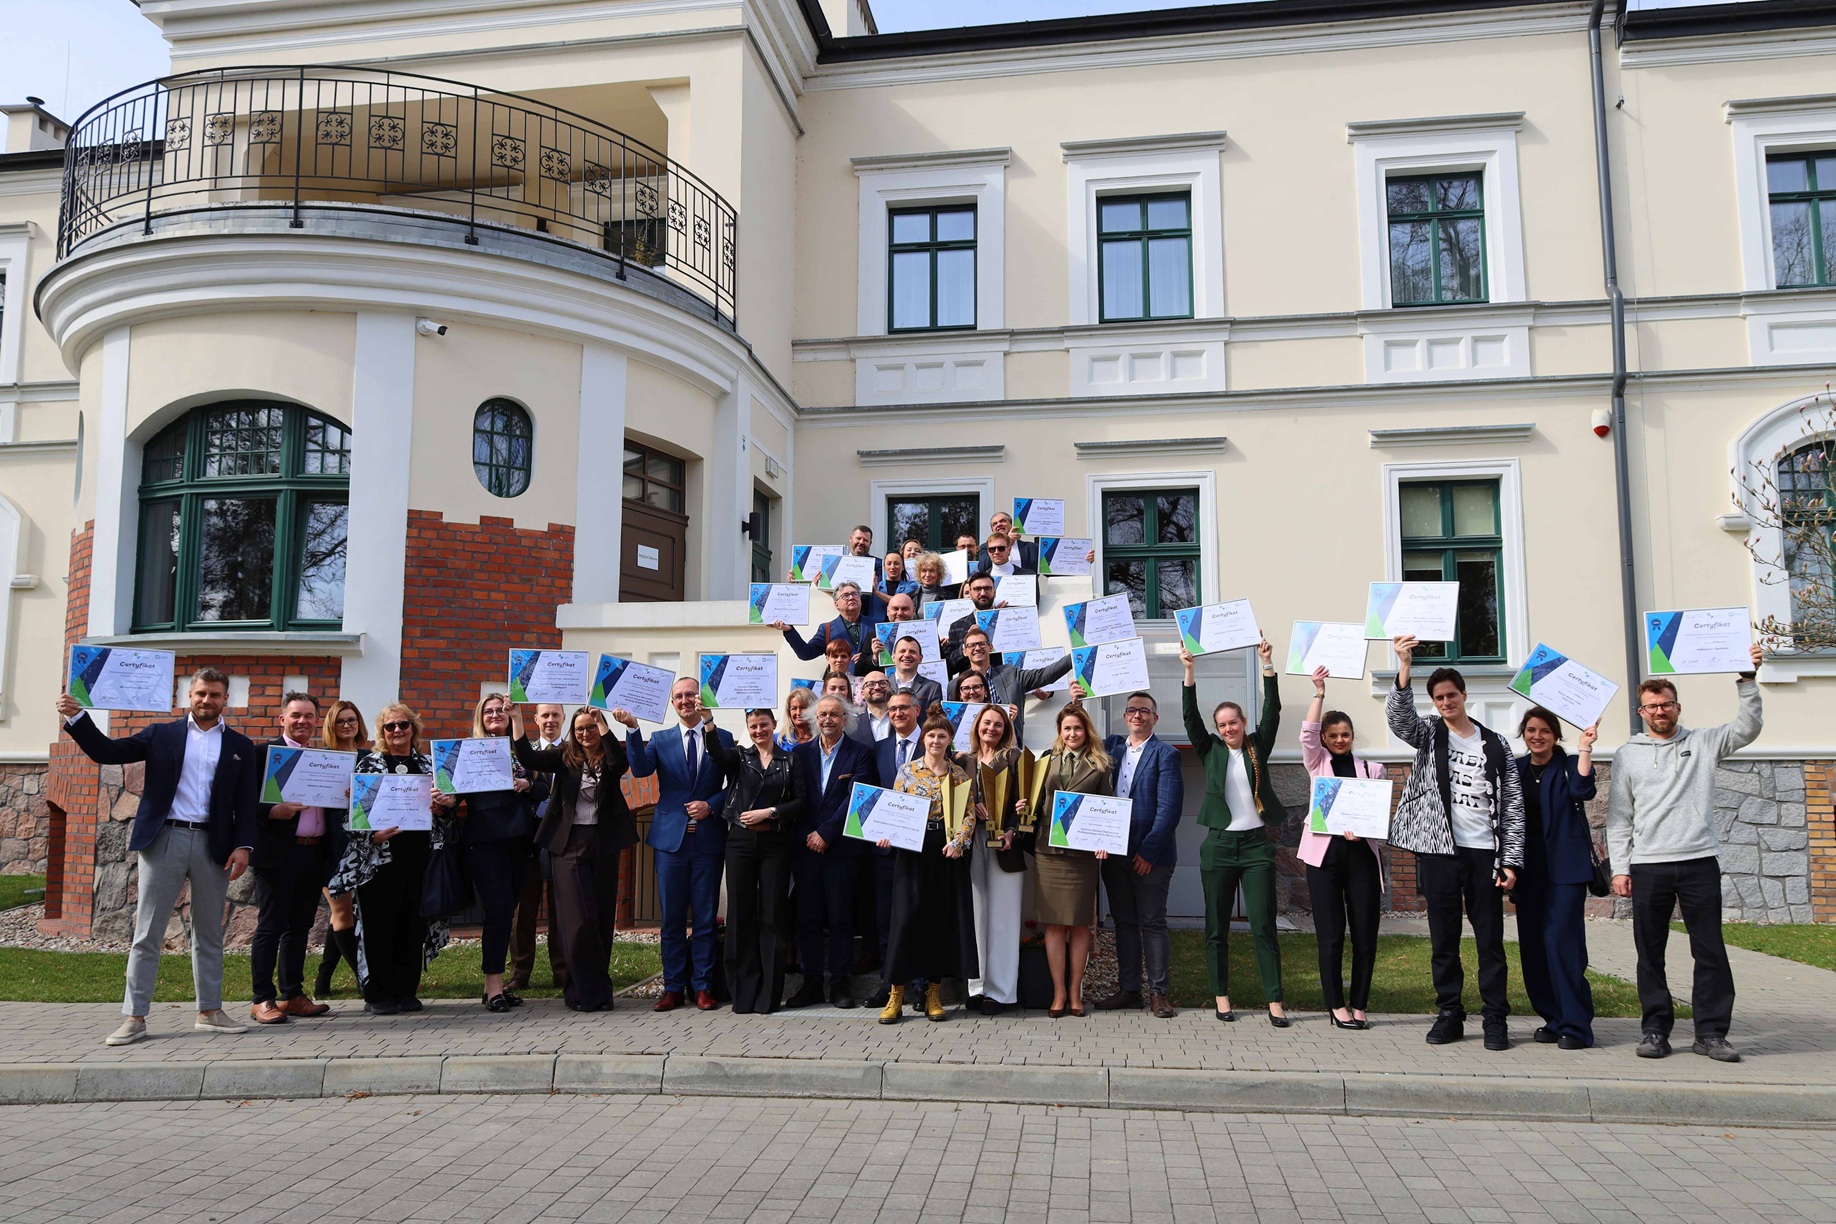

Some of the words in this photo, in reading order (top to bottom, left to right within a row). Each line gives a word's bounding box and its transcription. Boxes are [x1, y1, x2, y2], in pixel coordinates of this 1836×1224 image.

[1106, 651, 1131, 659] Certyfikat
[120, 661, 155, 669] Certyfikat
[633, 674, 659, 684] Certyfikat
[1568, 672, 1598, 691] Certyfikat
[888, 802, 915, 811] Certyfikat
